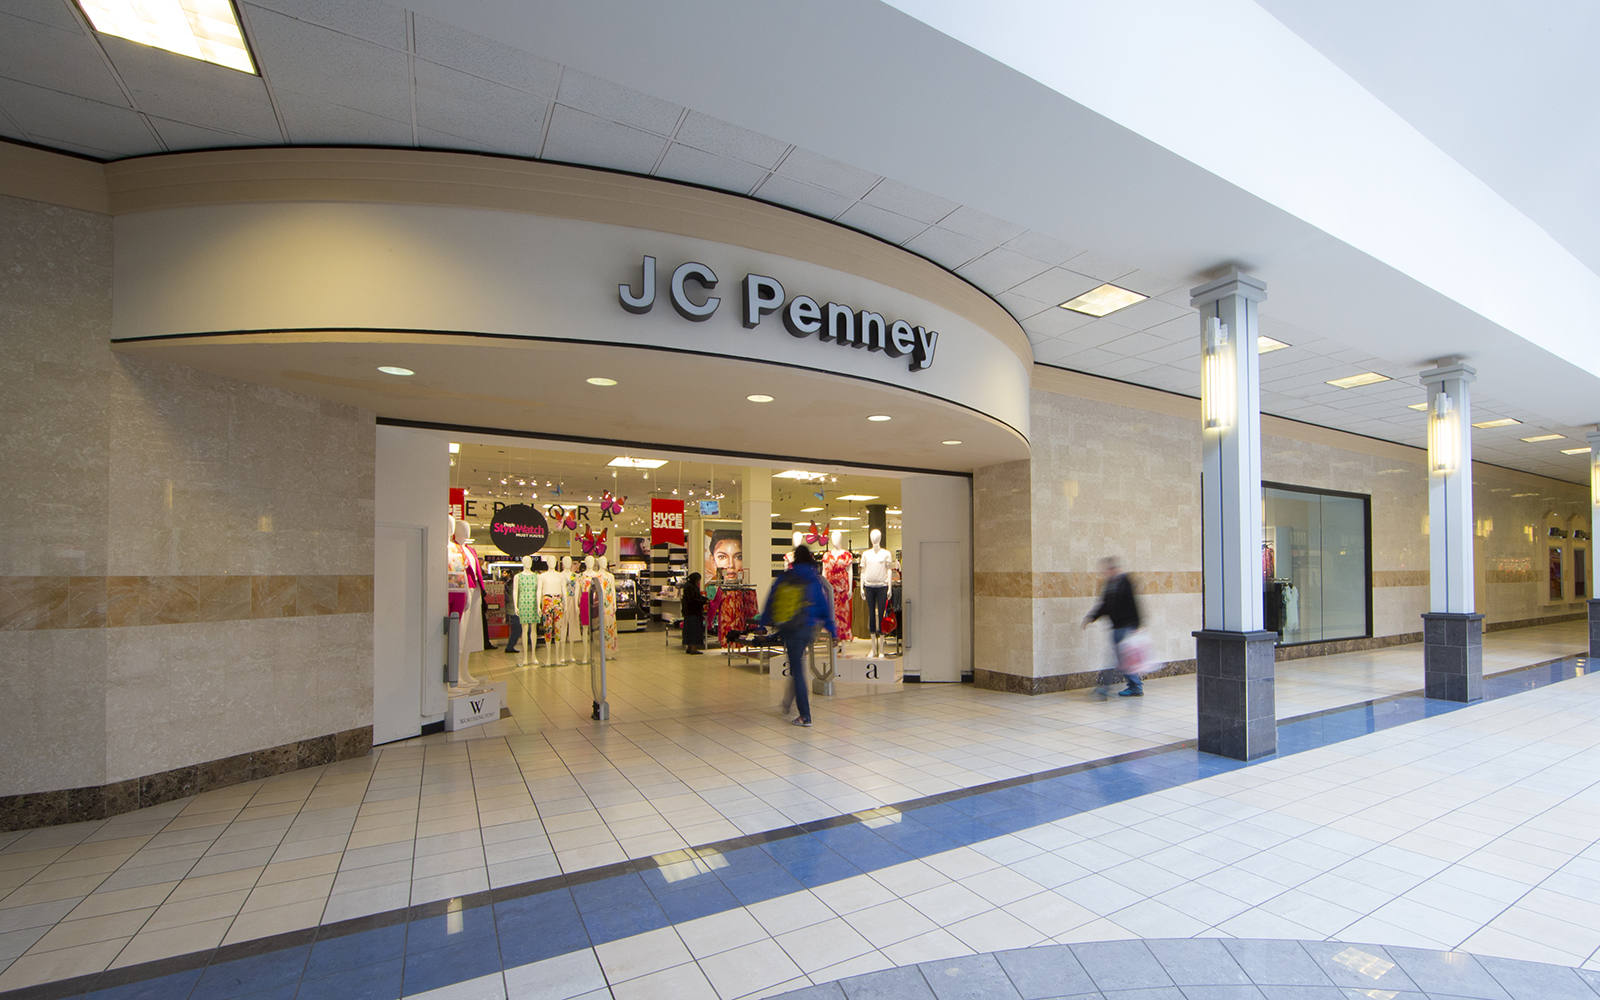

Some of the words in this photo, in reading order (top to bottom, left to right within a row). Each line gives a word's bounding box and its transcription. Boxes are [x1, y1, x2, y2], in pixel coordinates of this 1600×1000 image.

[741, 273, 939, 372] Penney
[653, 512, 682, 521] HUGE
[493, 522, 545, 536] StyleWatch
[653, 520, 682, 529] SALE
[469, 698, 485, 715] W
[459, 711, 495, 725] WORTHINGTON
